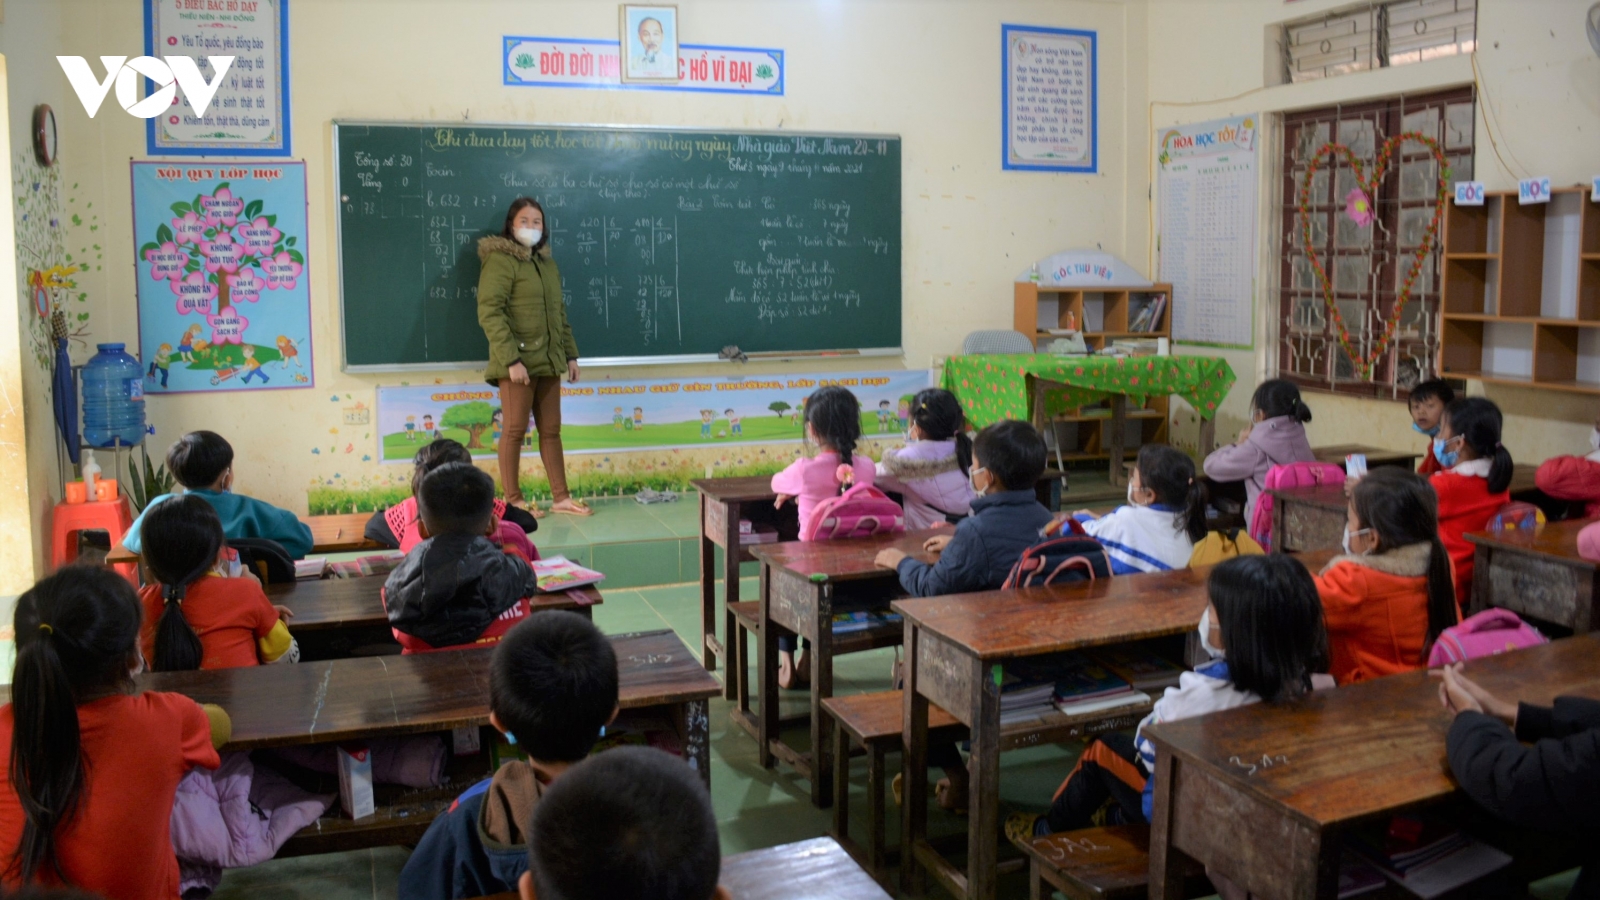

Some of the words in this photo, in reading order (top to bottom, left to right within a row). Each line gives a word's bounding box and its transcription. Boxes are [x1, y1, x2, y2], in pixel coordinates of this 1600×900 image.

[182, 34, 194, 47] Yêu
[223, 37, 234, 50] yêu
[237, 56, 252, 71] động
[256, 55, 264, 69] tốt
[540, 45, 565, 75] ĐỜI
[569, 47, 594, 76] ĐỜI
[690, 51, 708, 81] HỒ
[712, 56, 725, 82] VĨ
[729, 60, 752, 89] ĐẠI
[242, 77, 253, 92] luật
[256, 74, 264, 89] tốt
[224, 96, 236, 108] sinh
[241, 96, 252, 112] thật
[256, 96, 265, 108] tốt
[1174, 136, 1193, 148] HOA
[1195, 132, 1215, 149] HỌC
[1218, 124, 1236, 142] TỐT
[556, 130, 577, 149] học
[695, 136, 731, 160] ngày
[733, 134, 762, 154] Nhà
[760, 138, 791, 161] giáo
[791, 136, 817, 156] Việt
[818, 139, 852, 155] Nam
[400, 155, 412, 167] 30
[156, 166, 182, 181] NỘI
[187, 168, 214, 181] QUY
[219, 167, 248, 179] LỚP
[253, 168, 283, 181] HỌC
[1457, 182, 1483, 200] GÓC
[1520, 179, 1549, 200] HỌC
[440, 195, 460, 207] 632
[430, 216, 449, 228] 632
[580, 218, 599, 227] 420
[210, 244, 232, 252] KHÔNG
[180, 284, 201, 294] KHÔNG
[431, 389, 493, 401] CHÚNG
[560, 386, 594, 397] ÙNG
[598, 384, 646, 395] NHAU
[649, 382, 680, 393] GIỮ
[683, 383, 712, 392] GÌN
[787, 378, 816, 388] LỚP
[861, 377, 890, 387] ĐẸP
[1032, 837, 1110, 861] 3A2
